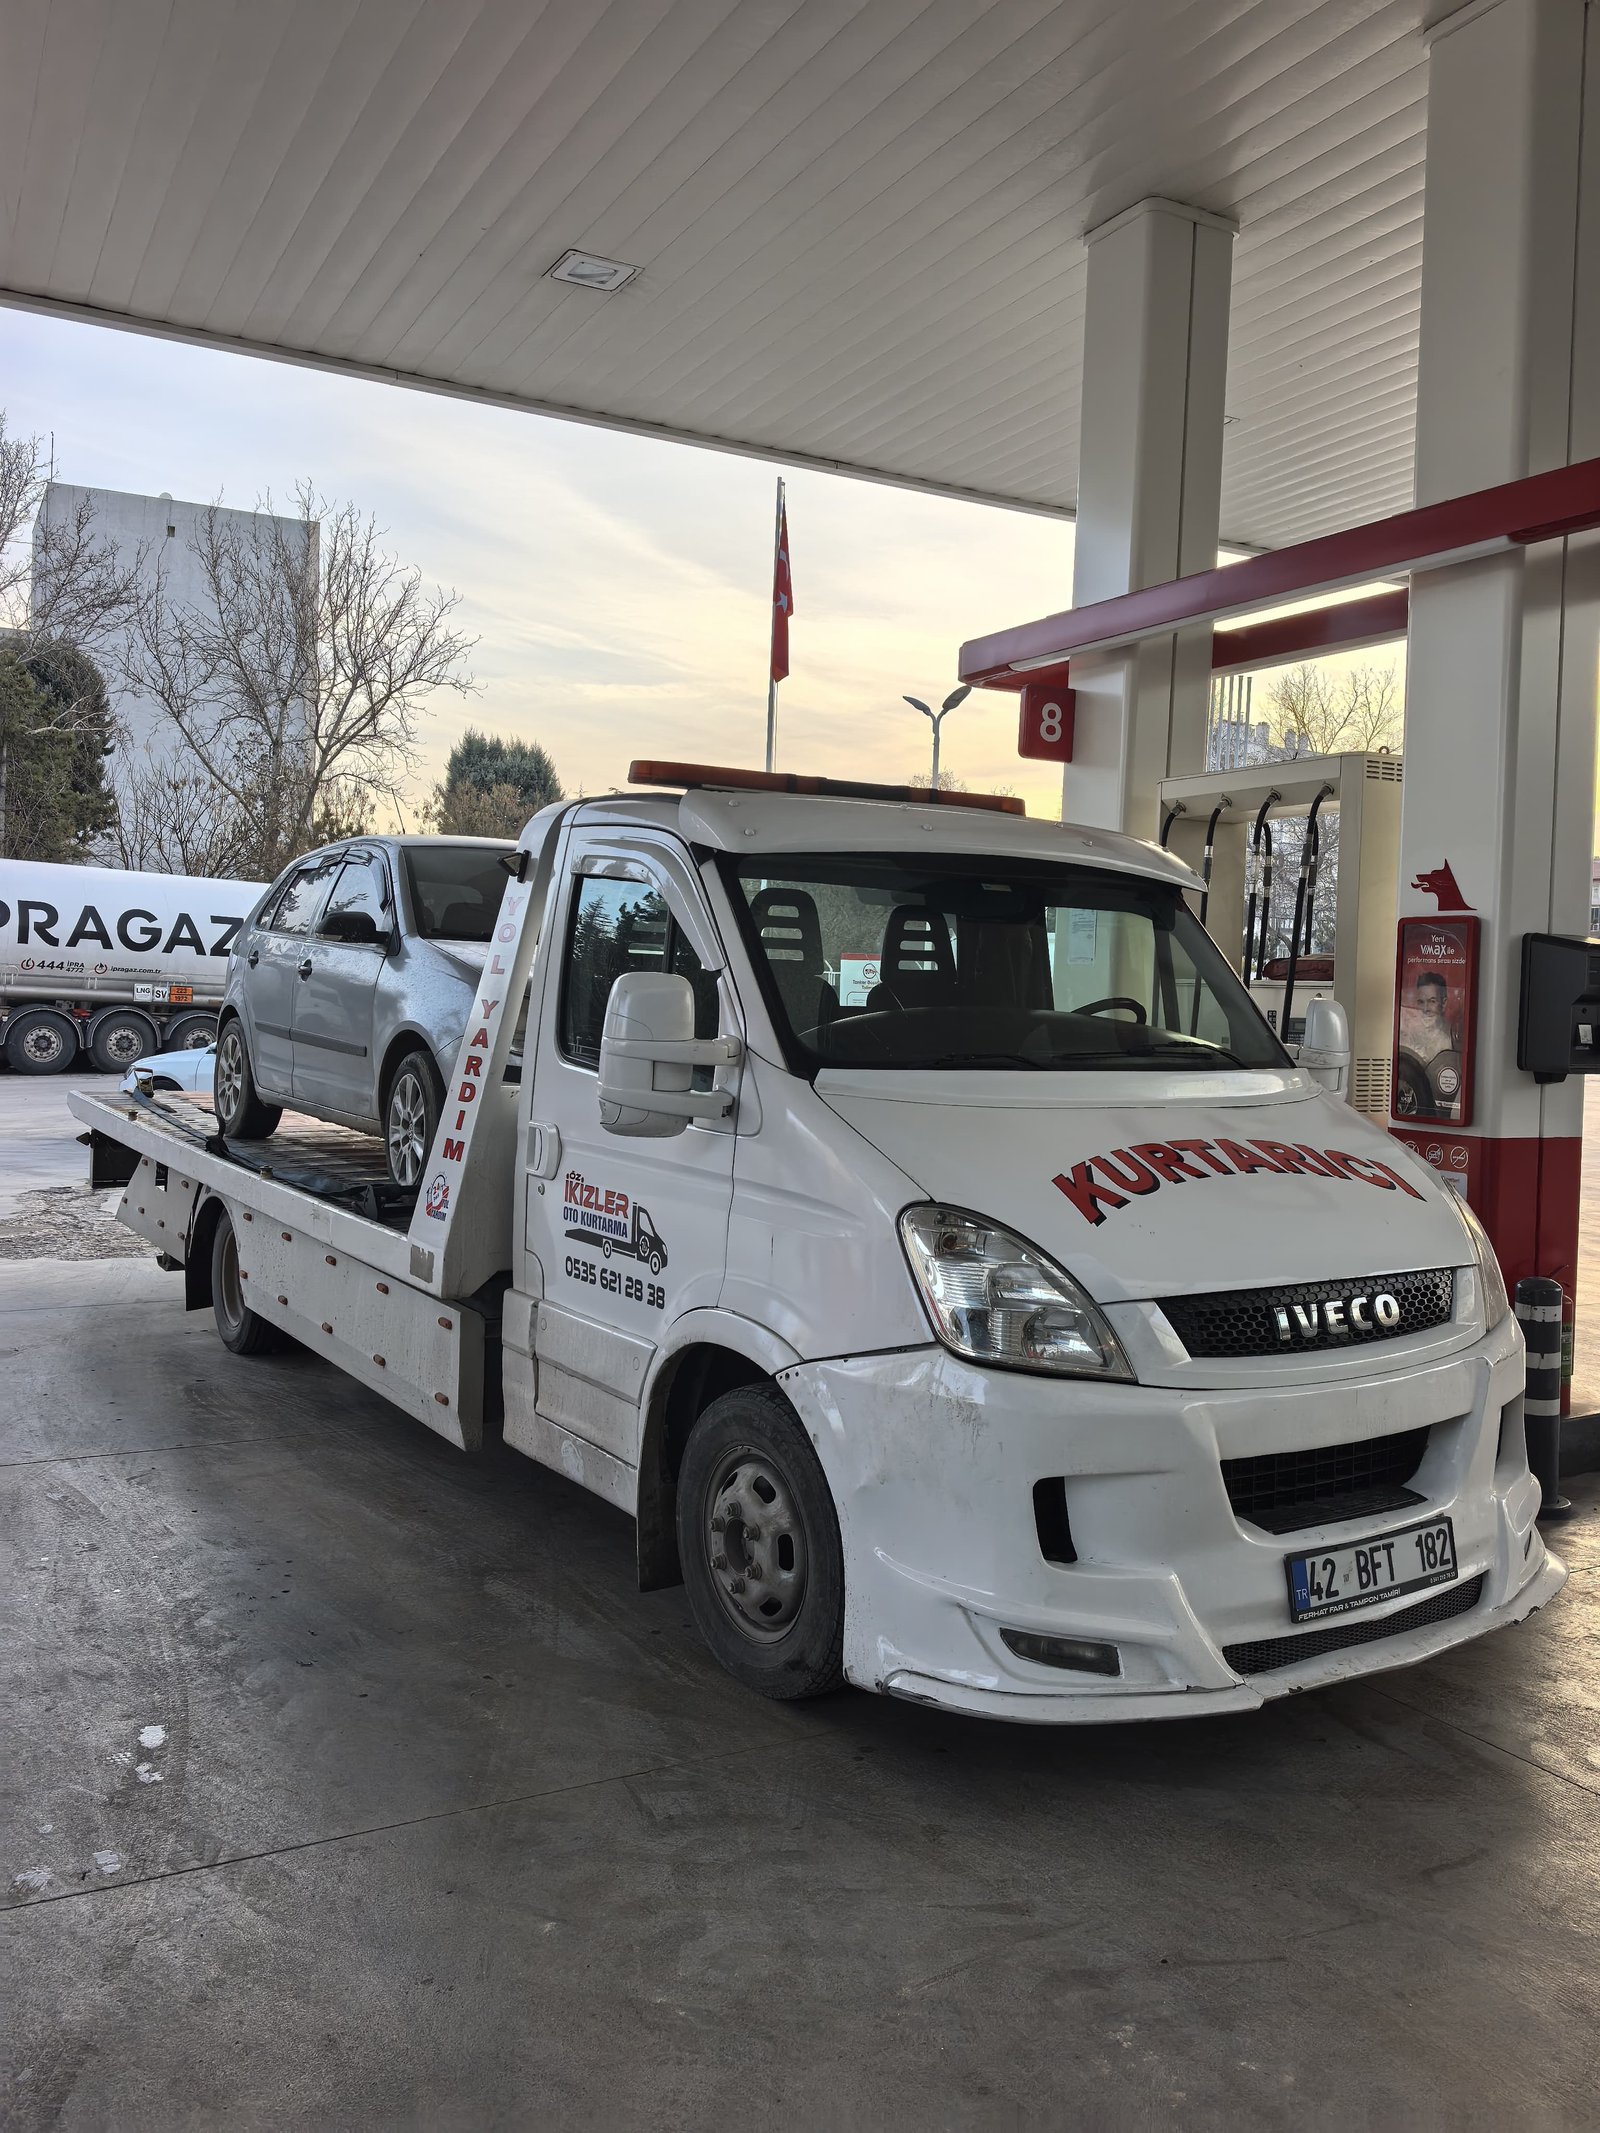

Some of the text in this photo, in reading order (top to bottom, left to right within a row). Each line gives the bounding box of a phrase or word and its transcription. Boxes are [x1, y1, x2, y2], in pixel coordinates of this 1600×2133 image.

[1040, 703, 1062, 742] 8
[1431, 934, 1445, 943] Yeni
[36, 960, 65, 970] 444
[110, 966, 162, 974] ipragaz.com.tr
[155, 989, 167, 999] SV
[442, 896, 525, 1163] YOL YARDIM
[564, 1179, 630, 1219] İKİZLER
[1051, 1138, 1427, 1228] KURTARICI
[563, 1206, 628, 1239] OTO KURTARMA
[565, 1255, 665, 1310] 0535 621 28 38
[1273, 1294, 1399, 1341] IVECO
[1310, 1528, 1451, 1601] 42 BFT 182
[1296, 1588, 1308, 1600] TR
[1298, 1607, 1329, 1621] FERHAT
[1329, 1604, 1344, 1613] FAR
[1349, 1594, 1379, 1608] TAMPON
[1379, 1588, 1401, 1599] TAMİRİ
